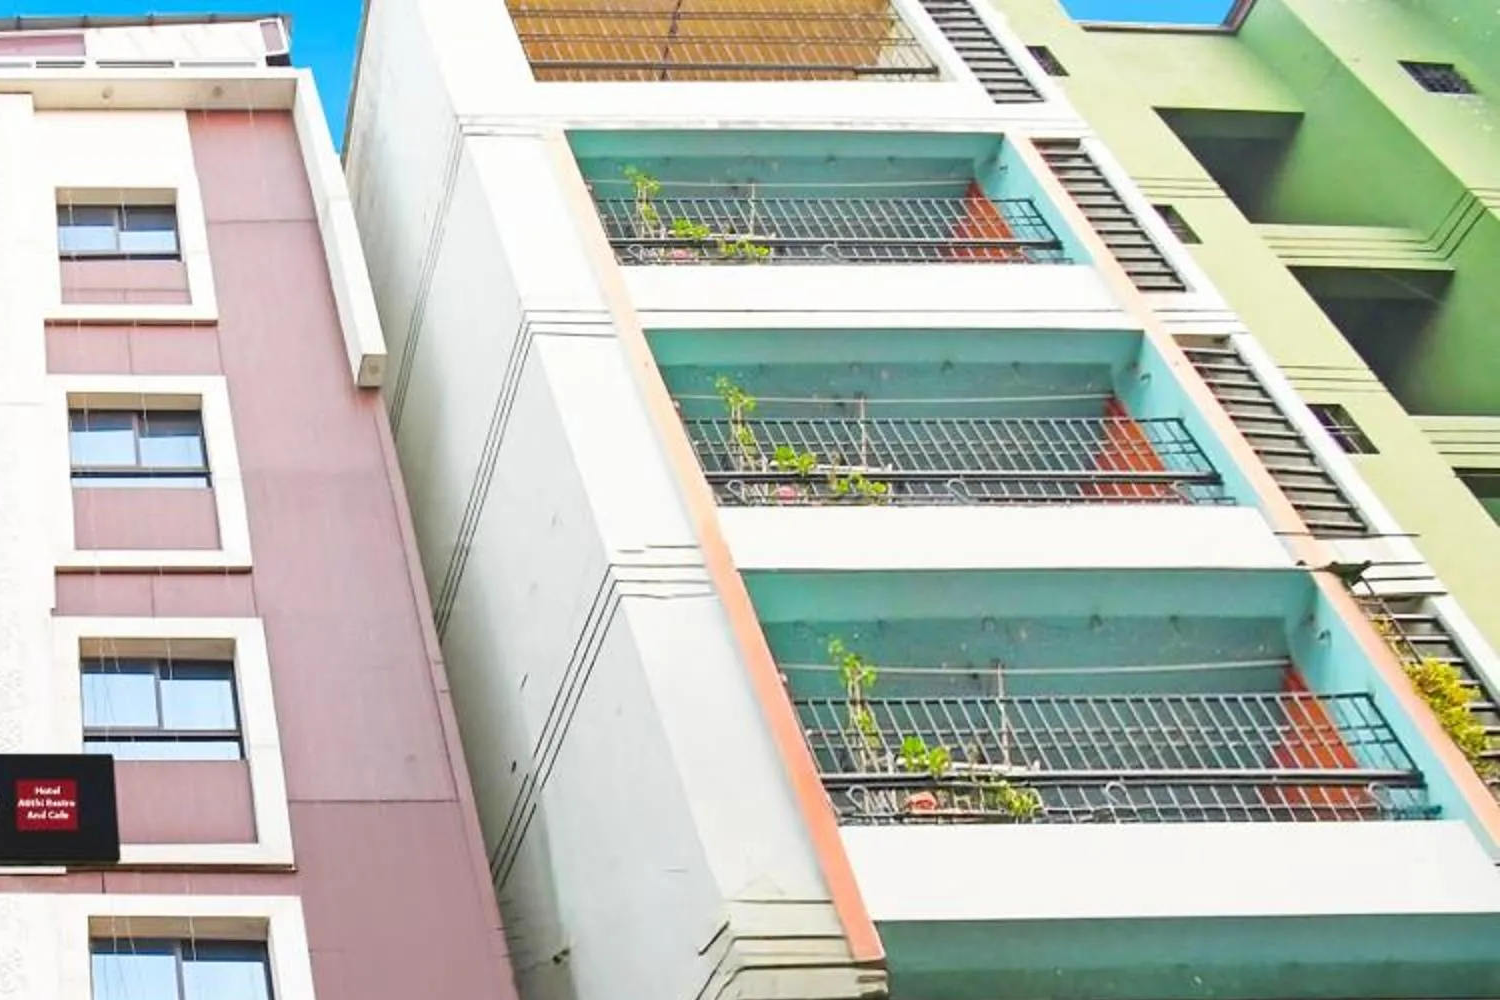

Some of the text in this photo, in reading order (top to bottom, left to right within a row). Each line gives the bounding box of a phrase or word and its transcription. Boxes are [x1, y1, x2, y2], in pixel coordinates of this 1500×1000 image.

[34, 785, 61, 795] Hotel
[27, 810, 69, 820] And Cafe
